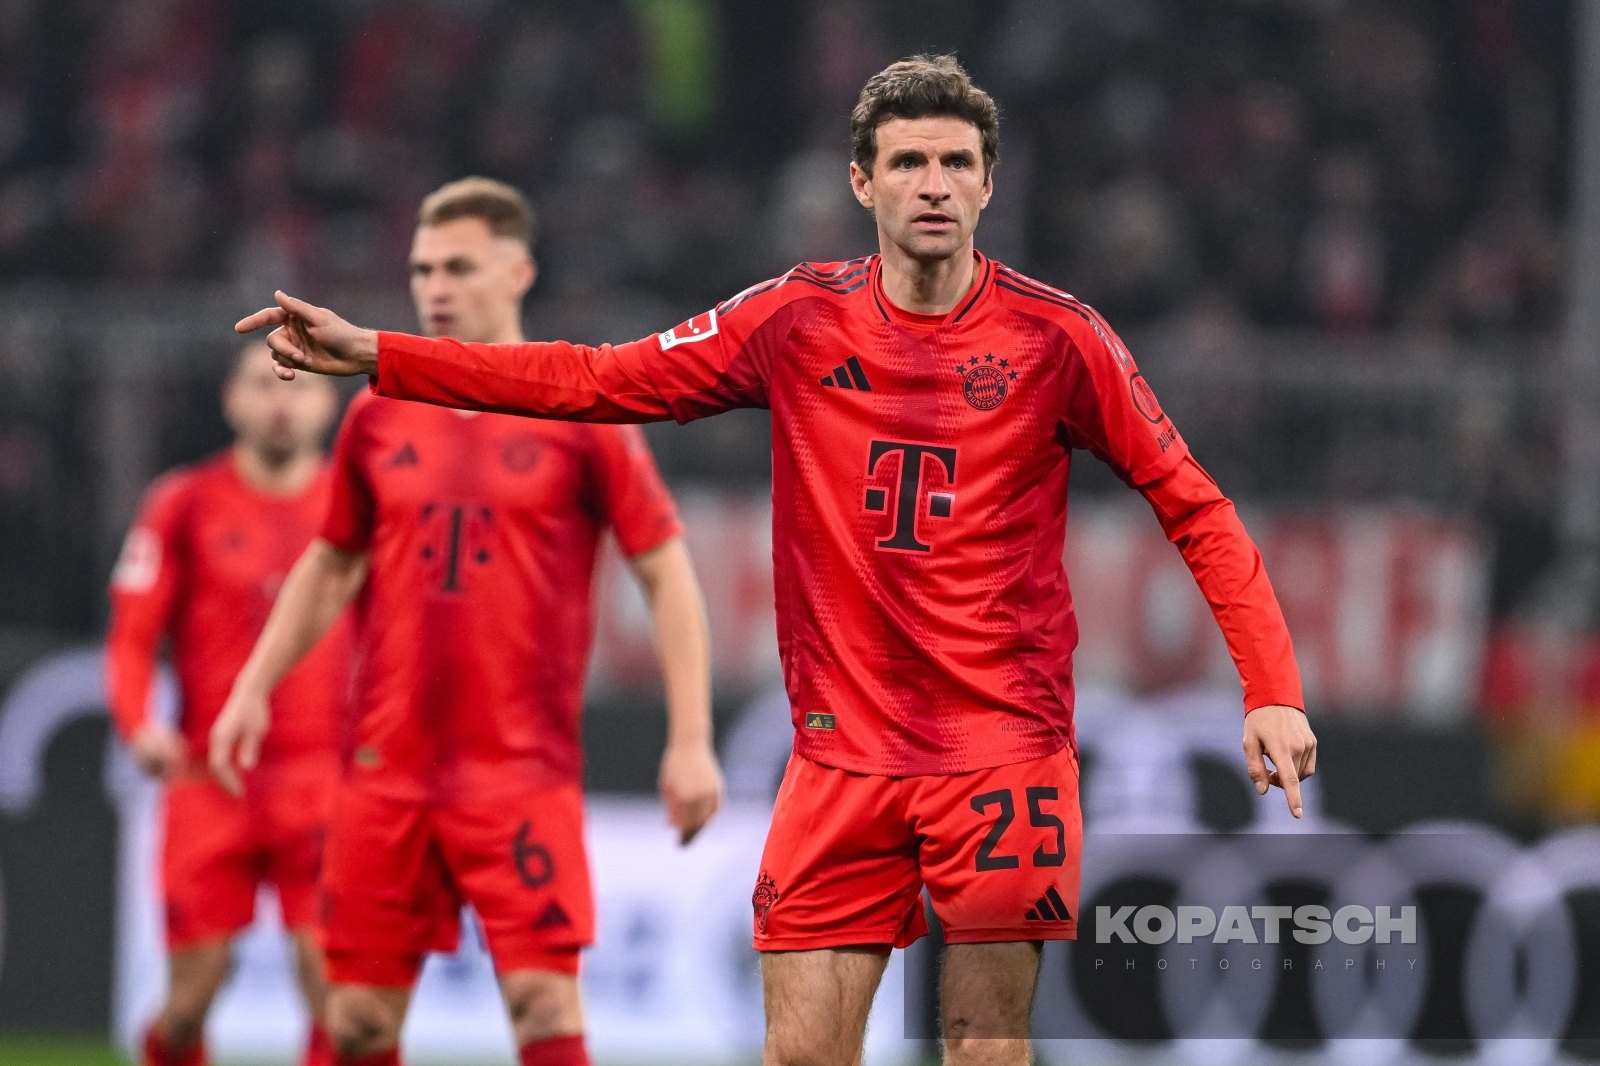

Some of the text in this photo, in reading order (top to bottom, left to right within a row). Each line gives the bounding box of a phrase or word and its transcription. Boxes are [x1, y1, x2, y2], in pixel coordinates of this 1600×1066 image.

[977, 368, 1005, 387] BAYERN
[865, 440, 957, 552] T
[513, 820, 554, 889] 6
[970, 787, 1066, 872] 25
